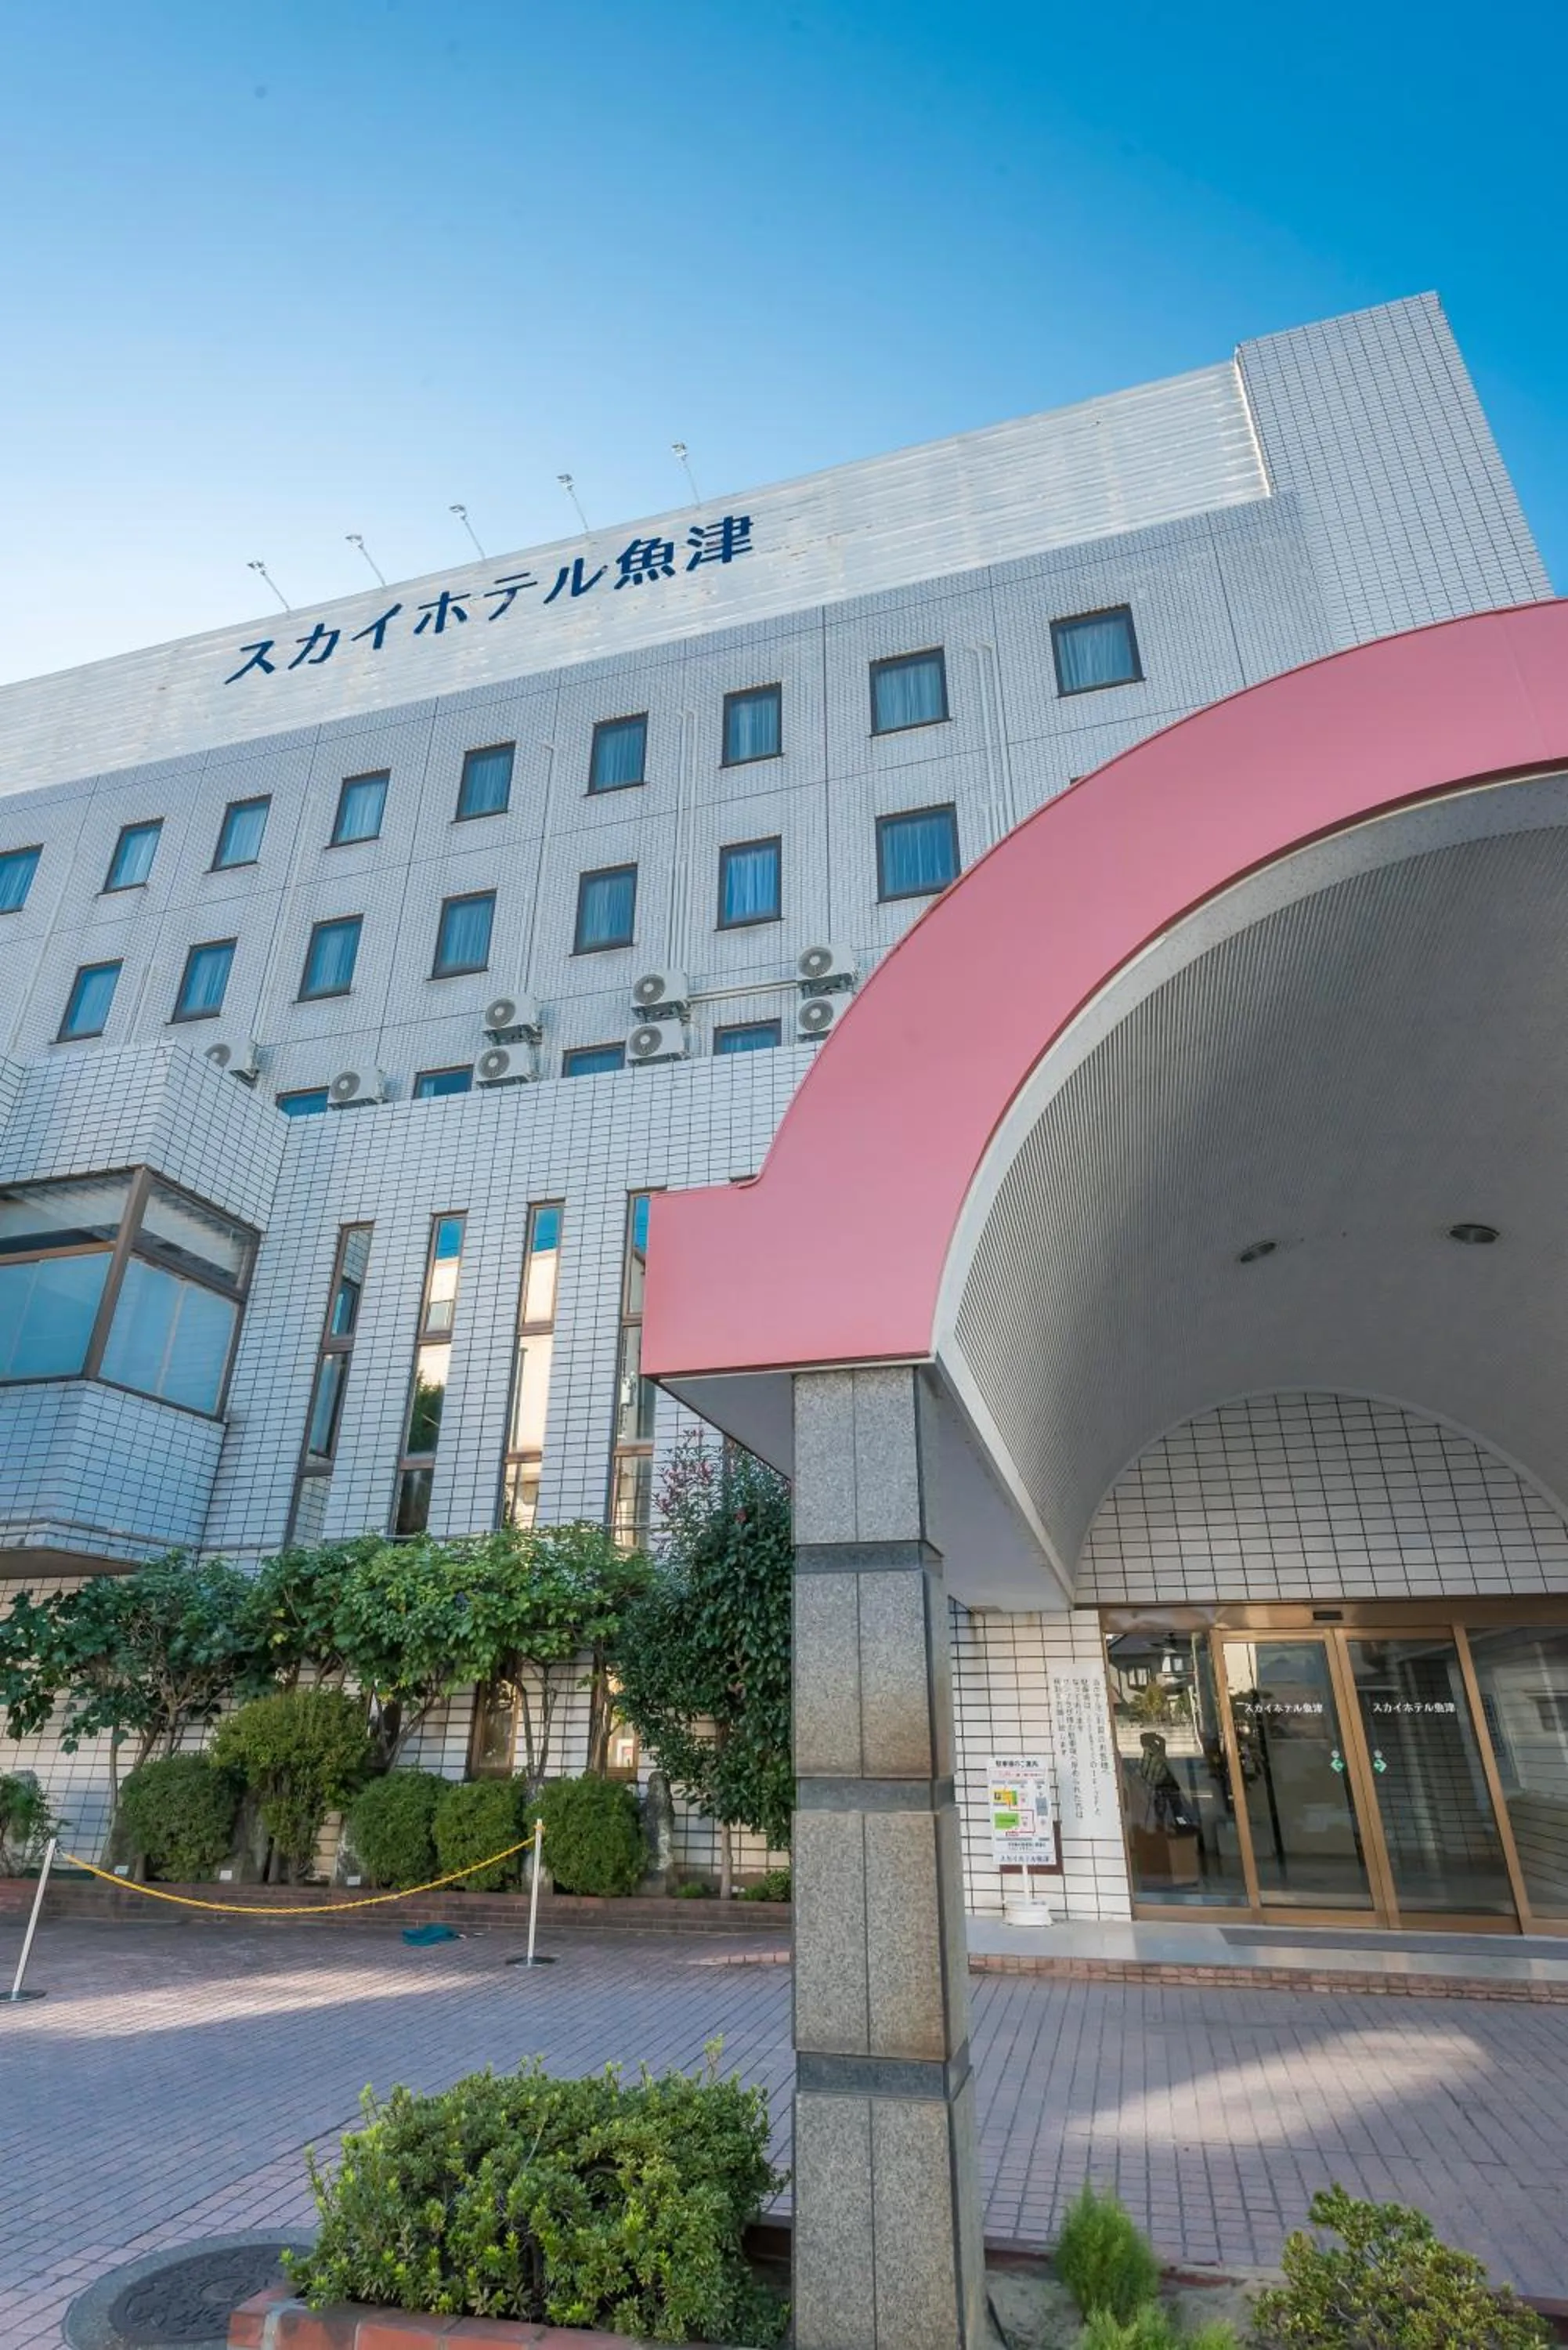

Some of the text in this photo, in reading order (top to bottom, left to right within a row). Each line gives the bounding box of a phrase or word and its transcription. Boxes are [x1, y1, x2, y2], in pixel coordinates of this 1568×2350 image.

[224, 515, 754, 685] スカイホテル魚津
[1244, 1701, 1324, 1714] スカイホテル魚津
[1372, 1701, 1456, 1714] スカイホテル魚津
